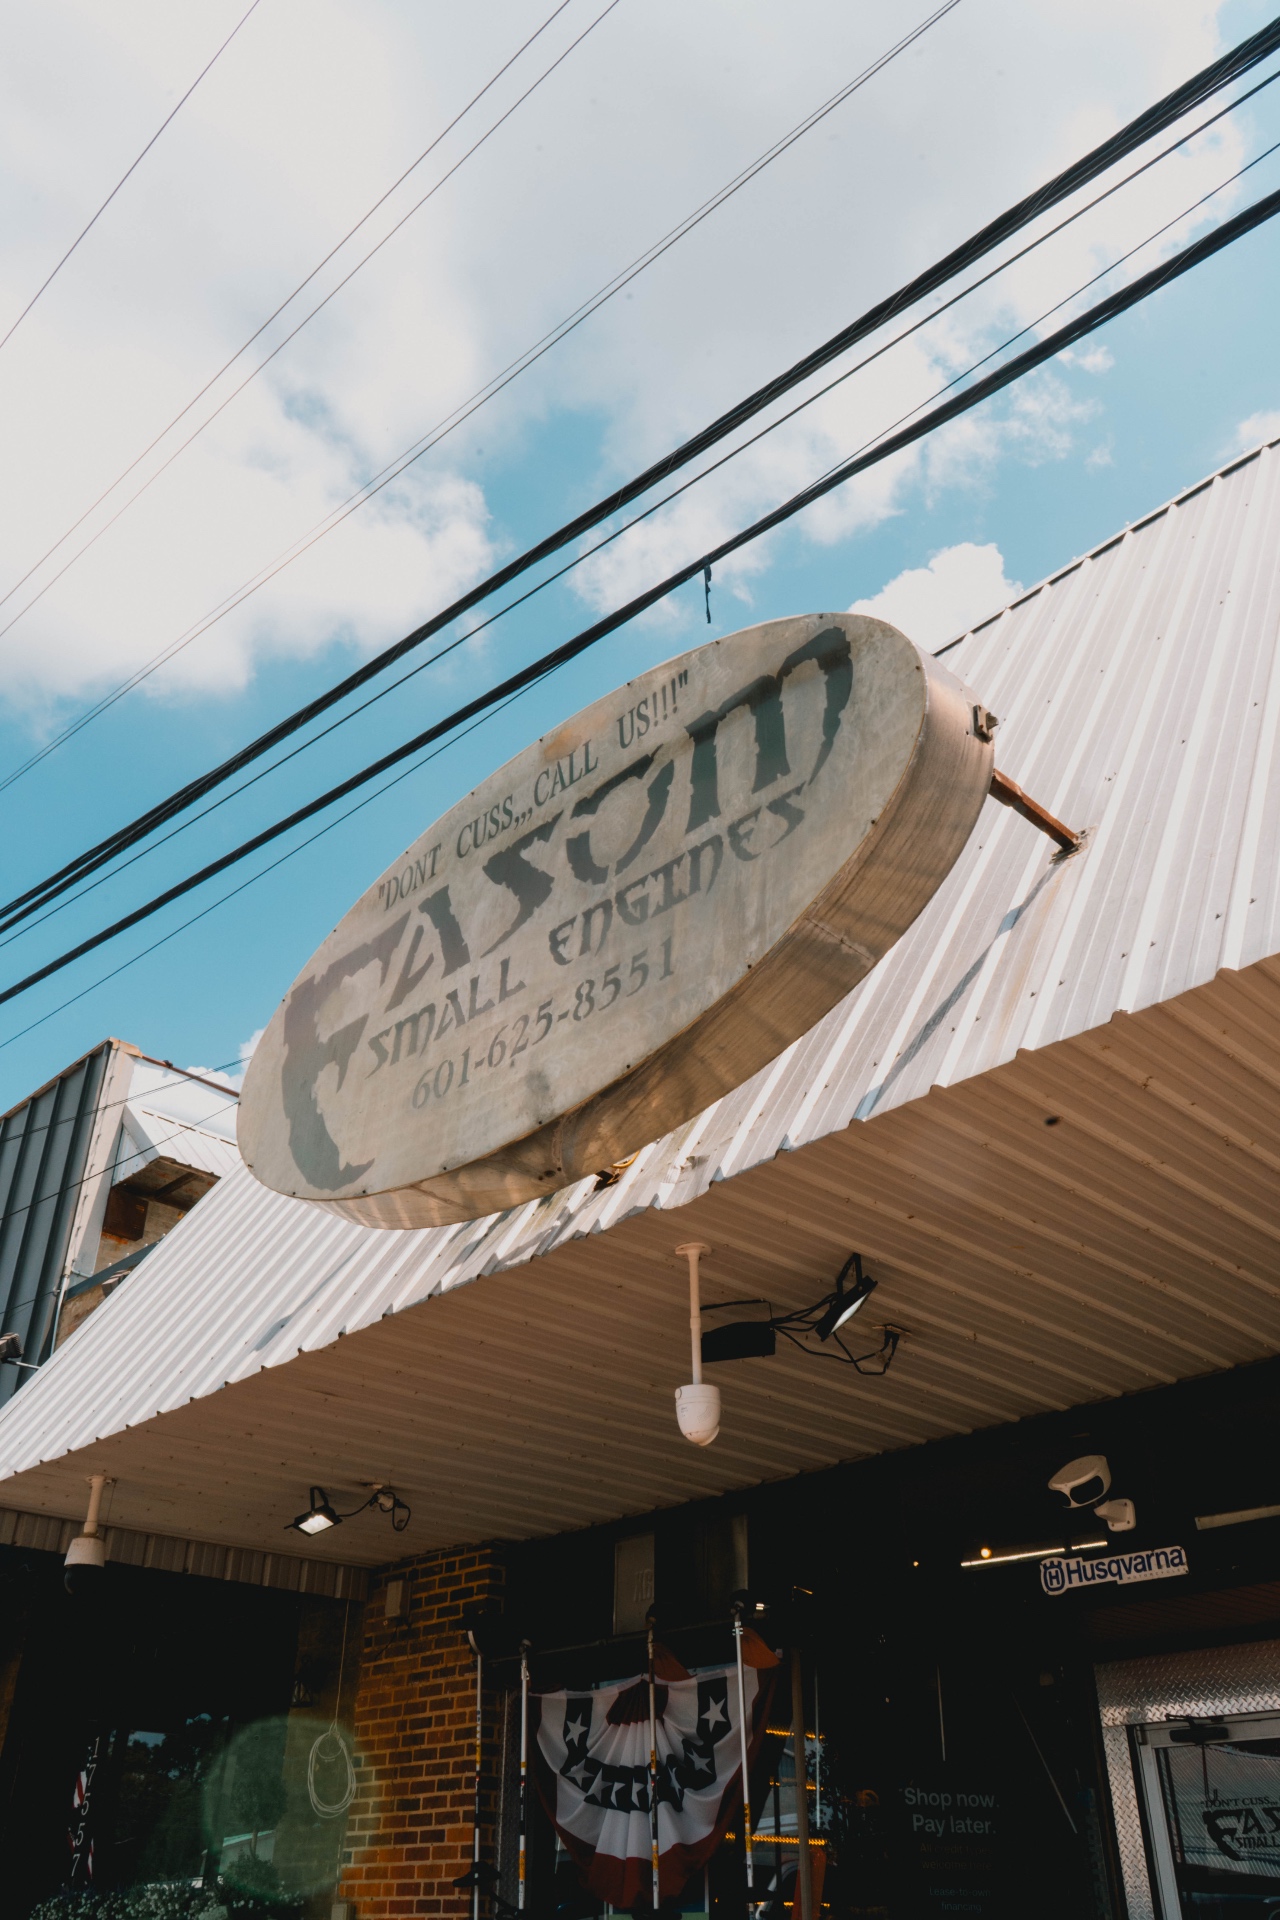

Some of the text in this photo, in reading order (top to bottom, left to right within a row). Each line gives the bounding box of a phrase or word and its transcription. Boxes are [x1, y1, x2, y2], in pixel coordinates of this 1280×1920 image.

[364, 955, 528, 1080] SMALL
[411, 935, 675, 1111] 601-625-8551
[1065, 1548, 1185, 1585] Husqvarna
[904, 1787, 1000, 1811] Shop now.
[912, 1813, 997, 1838] Pay later.
[941, 1901, 982, 1914] financing
